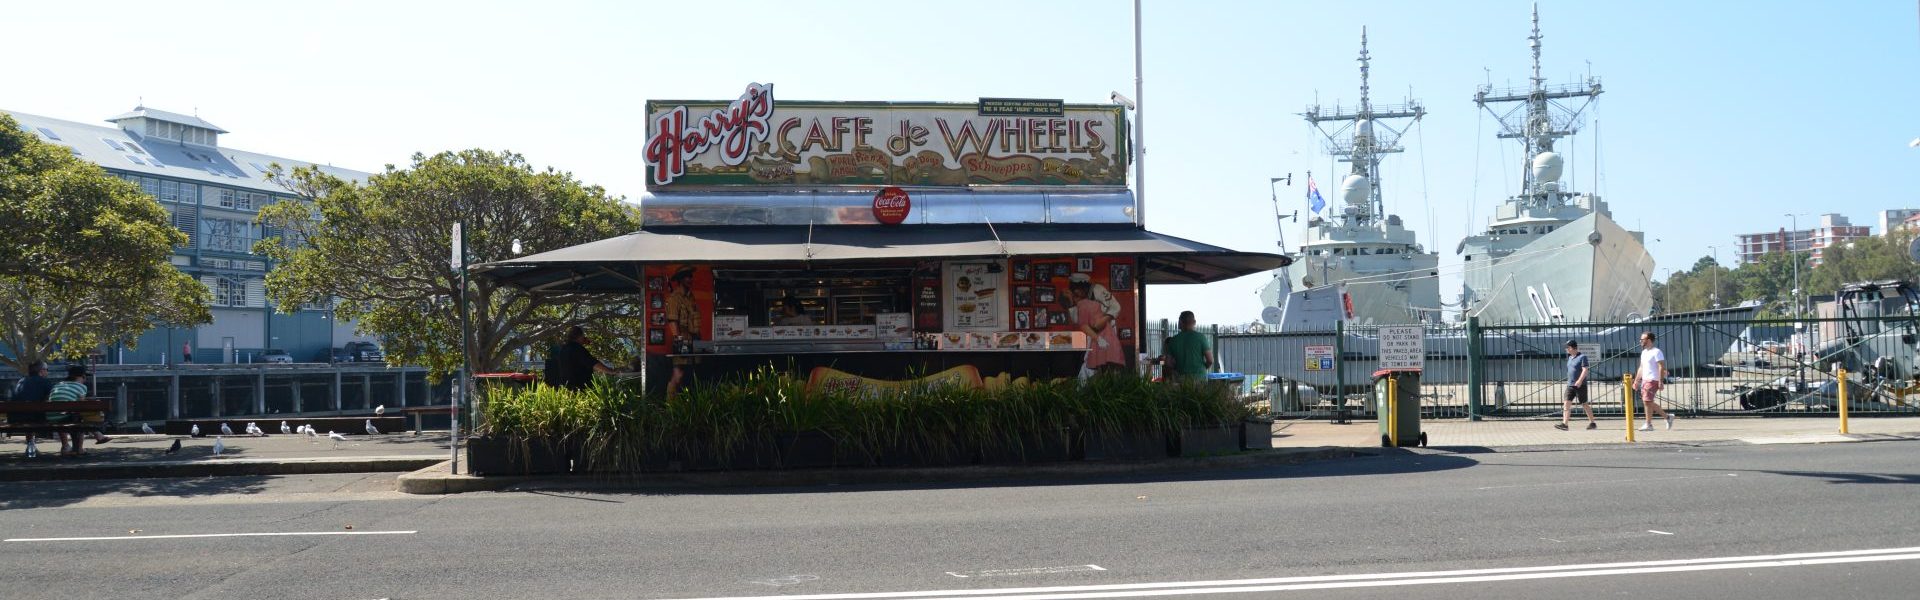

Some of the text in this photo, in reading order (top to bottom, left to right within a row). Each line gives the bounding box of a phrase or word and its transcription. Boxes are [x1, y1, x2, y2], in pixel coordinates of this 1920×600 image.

[644, 84, 773, 184] Harry's
[776, 116, 1107, 165] CAFE de WHEELS
[968, 159, 1034, 178] Schweppes
[875, 195, 907, 209] Coca-Cola
